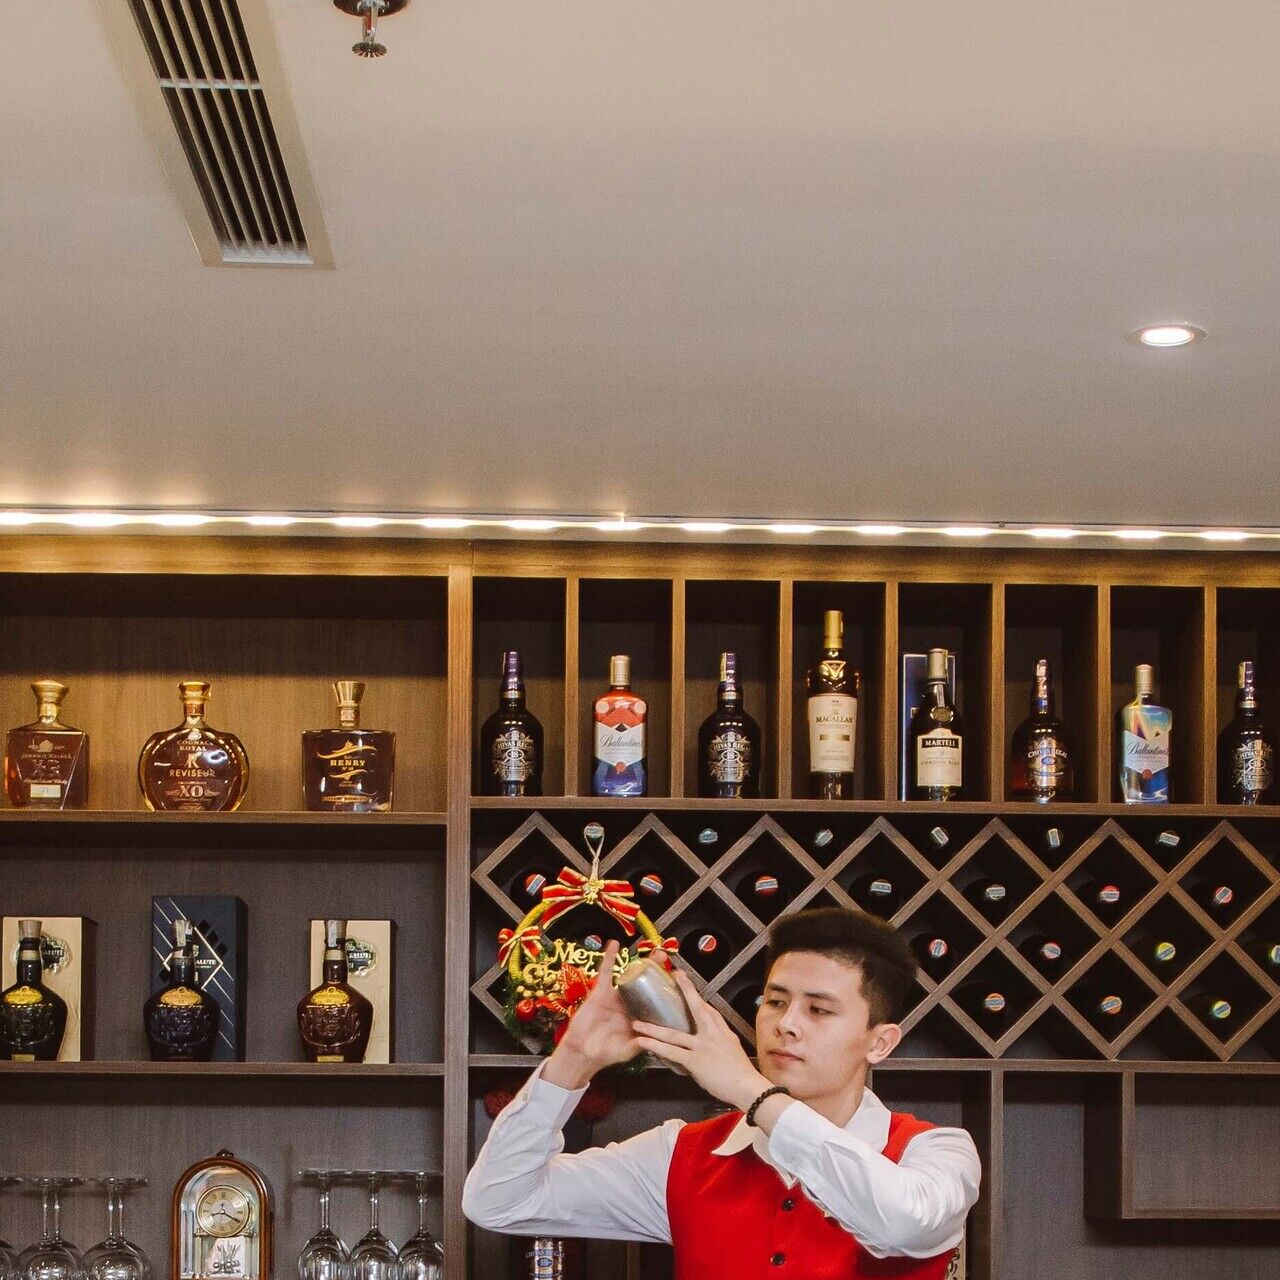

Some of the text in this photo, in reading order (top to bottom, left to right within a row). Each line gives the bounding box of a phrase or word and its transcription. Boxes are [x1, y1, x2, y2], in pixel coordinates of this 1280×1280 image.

[925, 739, 956, 747] MARTELL
[169, 769, 216, 778] REVISEUR
[180, 785, 204, 797] XO
